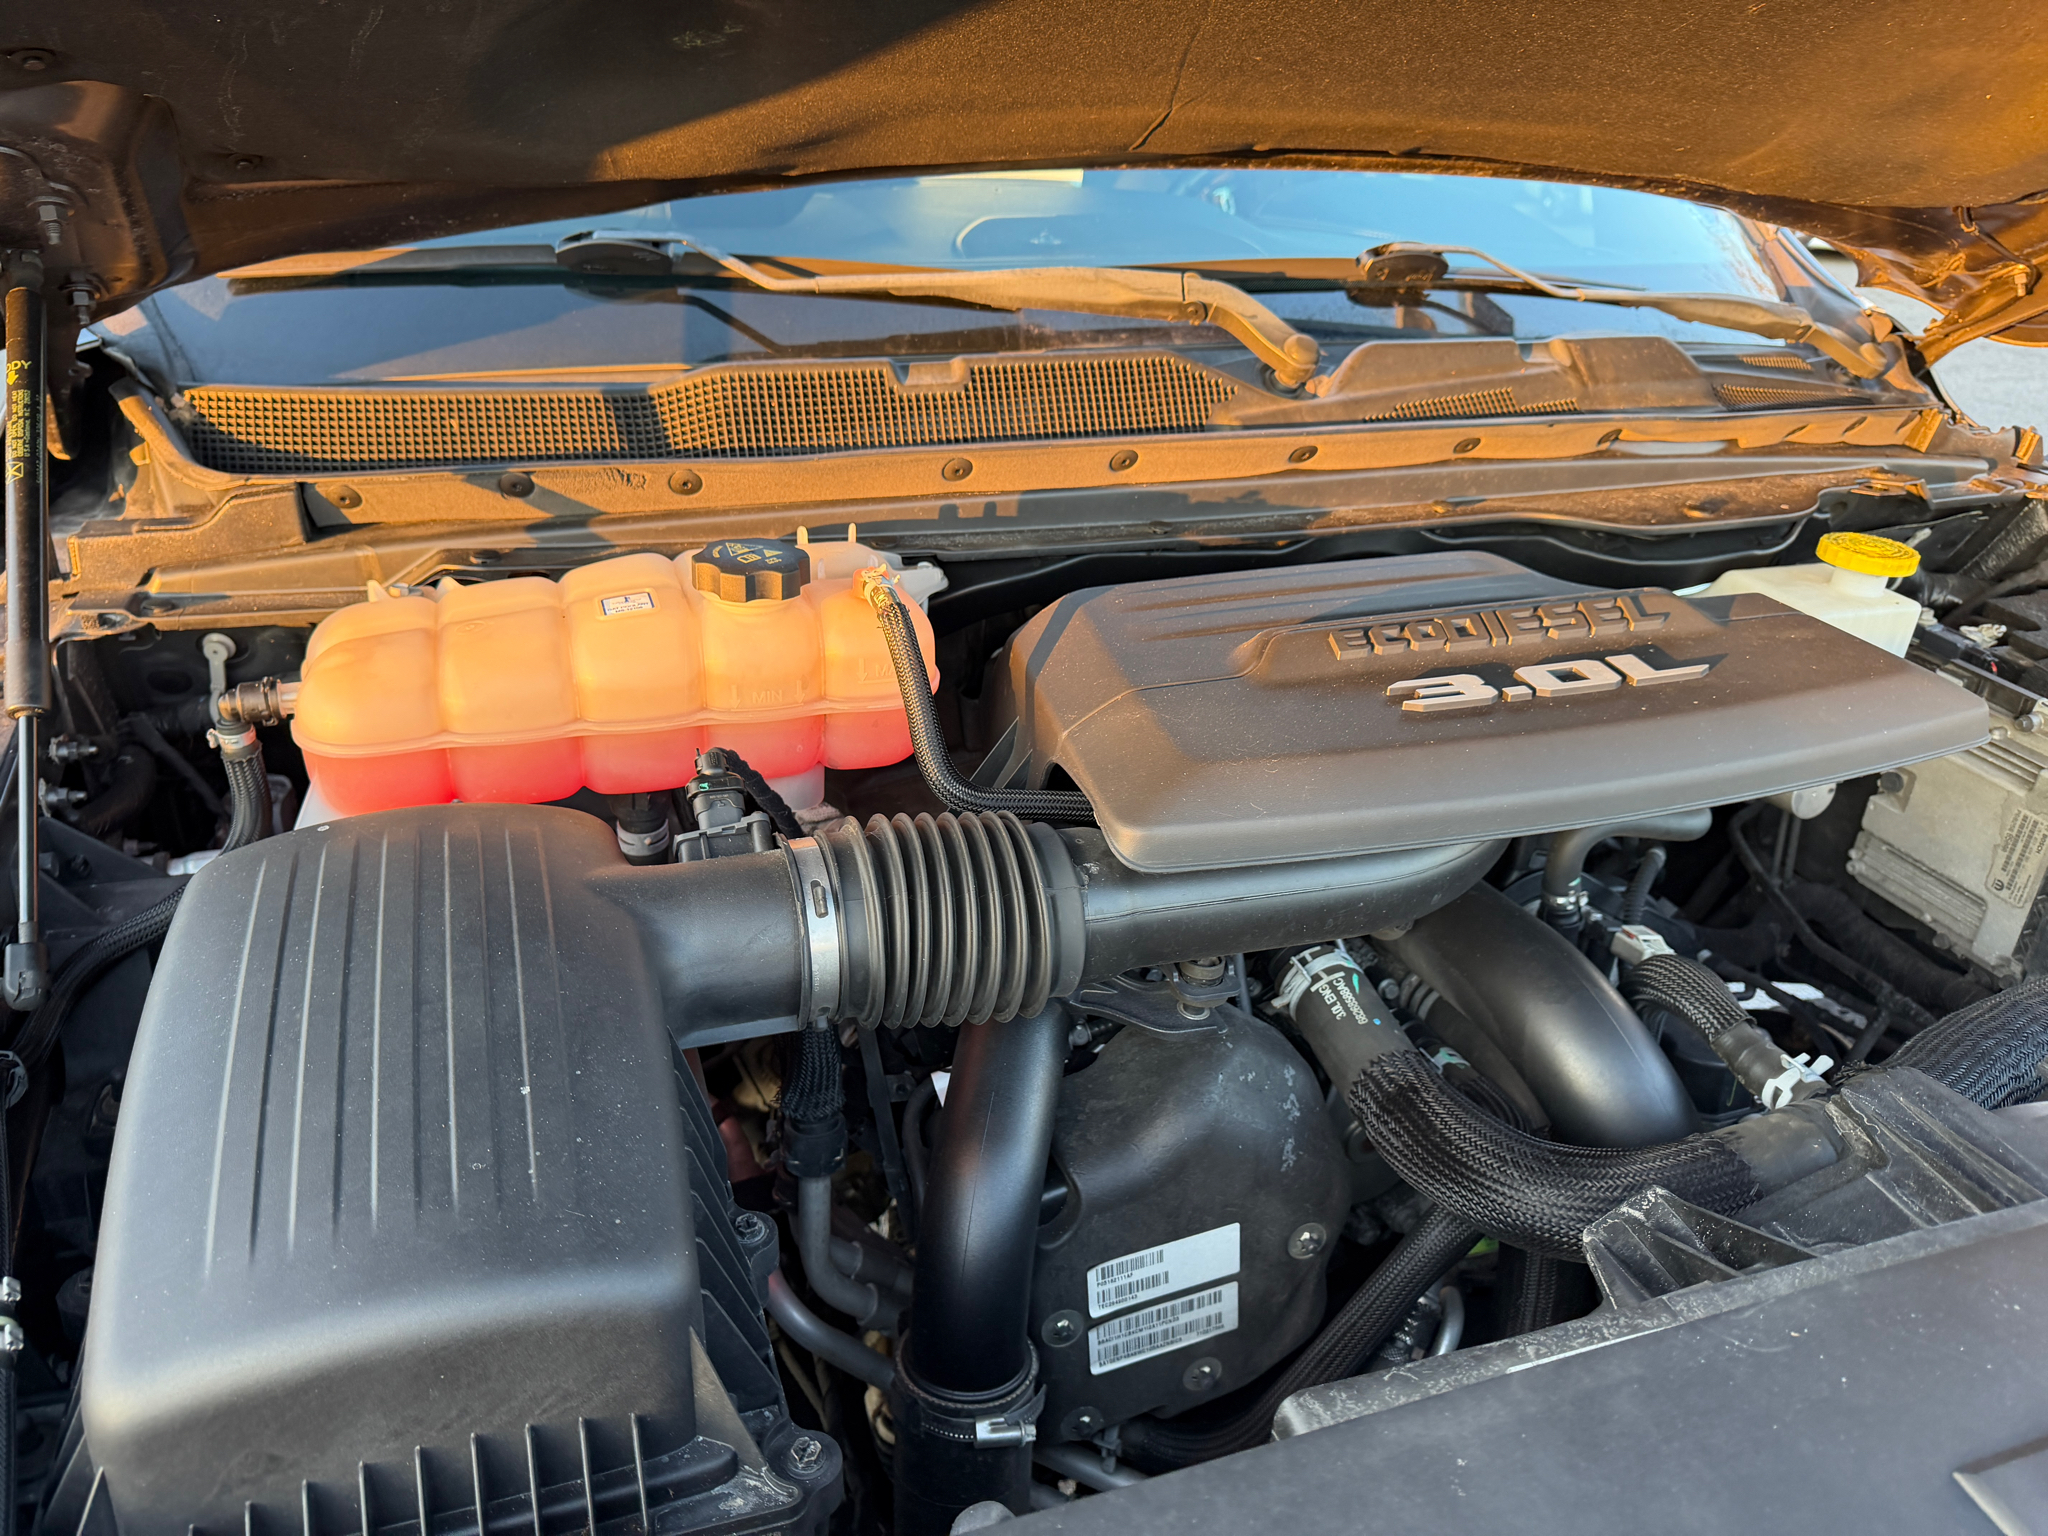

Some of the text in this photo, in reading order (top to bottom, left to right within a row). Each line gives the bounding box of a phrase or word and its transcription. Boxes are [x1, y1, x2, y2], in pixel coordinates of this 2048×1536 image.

[1329, 596, 1668, 661] ECODIESEL
[752, 689, 783, 704] MIN
[1386, 653, 1710, 713] 3.0L
[2035, 833, 2048, 854] BOSCH
[1318, 983, 1347, 1021] 3.0L ENG
